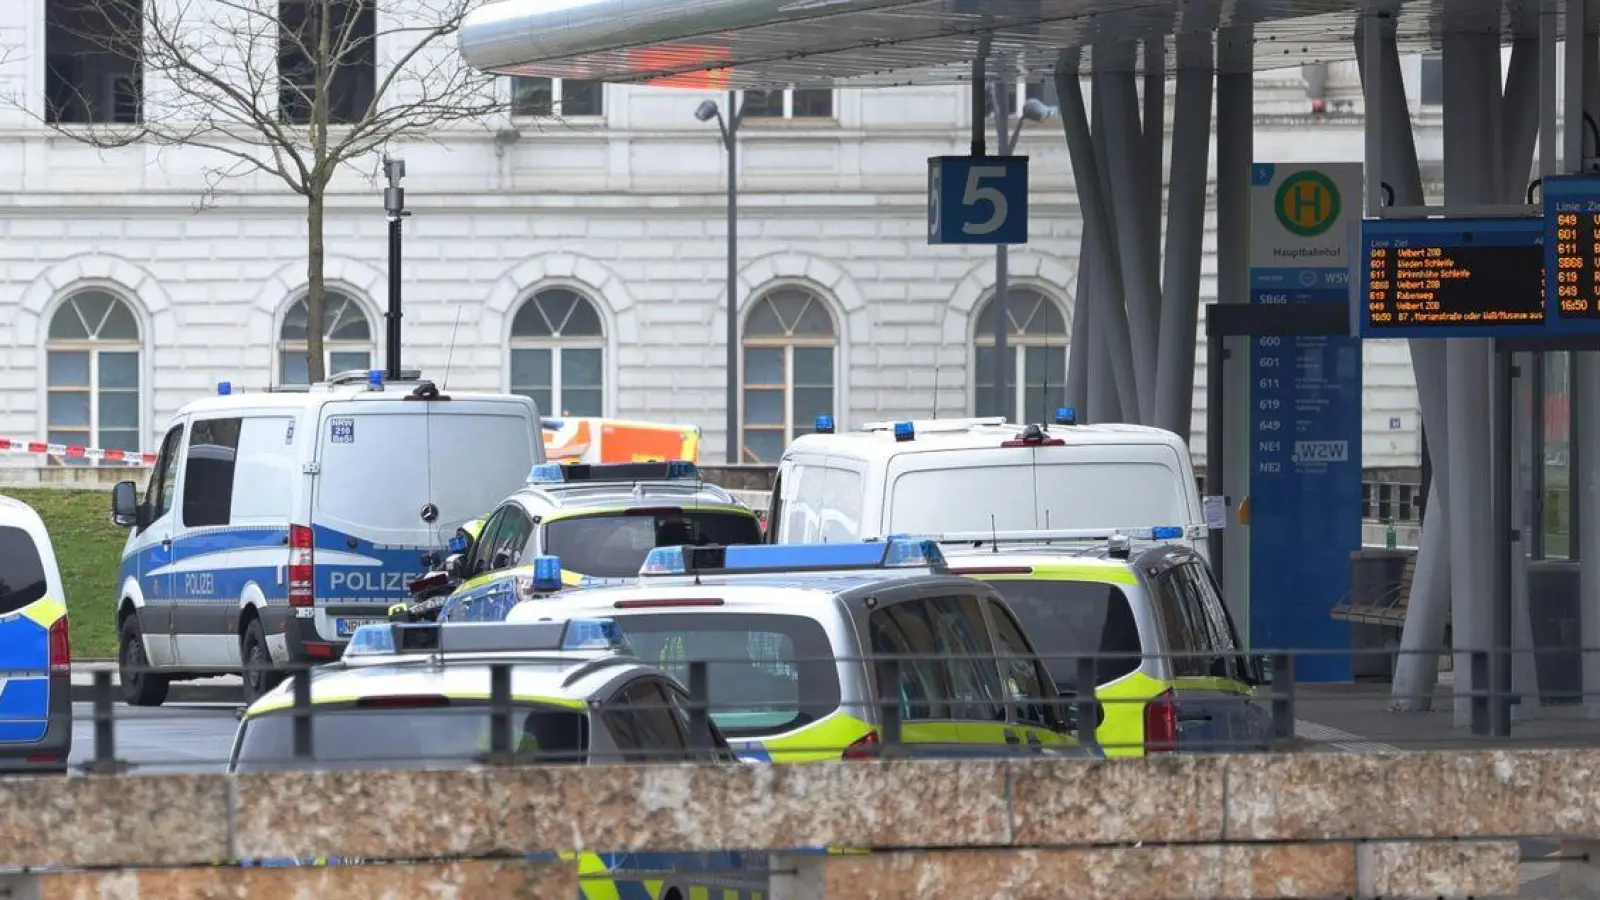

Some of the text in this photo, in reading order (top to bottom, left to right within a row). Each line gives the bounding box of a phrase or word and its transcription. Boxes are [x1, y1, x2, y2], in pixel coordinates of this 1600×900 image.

[961, 166, 1008, 235] 5
[1556, 200, 1581, 212] Linie
[1558, 214, 1577, 225] 649
[1558, 229, 1577, 240] 601
[1394, 239, 1408, 247] Ziel
[1558, 243, 1577, 254] 611
[1273, 247, 1341, 259] Hauptbahnhof
[1370, 270, 1385, 279] 611
[1558, 271, 1578, 282] 619
[1558, 285, 1578, 297] 649
[1259, 294, 1288, 305] SB66
[1561, 299, 1588, 312] 16:50
[1463, 312, 1481, 321] oder
[1259, 336, 1281, 347] 600
[1259, 357, 1280, 368] 601
[1259, 378, 1280, 388] 611
[1259, 399, 1281, 410] 619
[1259, 420, 1281, 431] 649
[1259, 441, 1281, 452] NE1
[1259, 462, 1281, 473] NE2
[185, 572, 215, 595] POLIZEI
[330, 571, 417, 591] POLIZE
